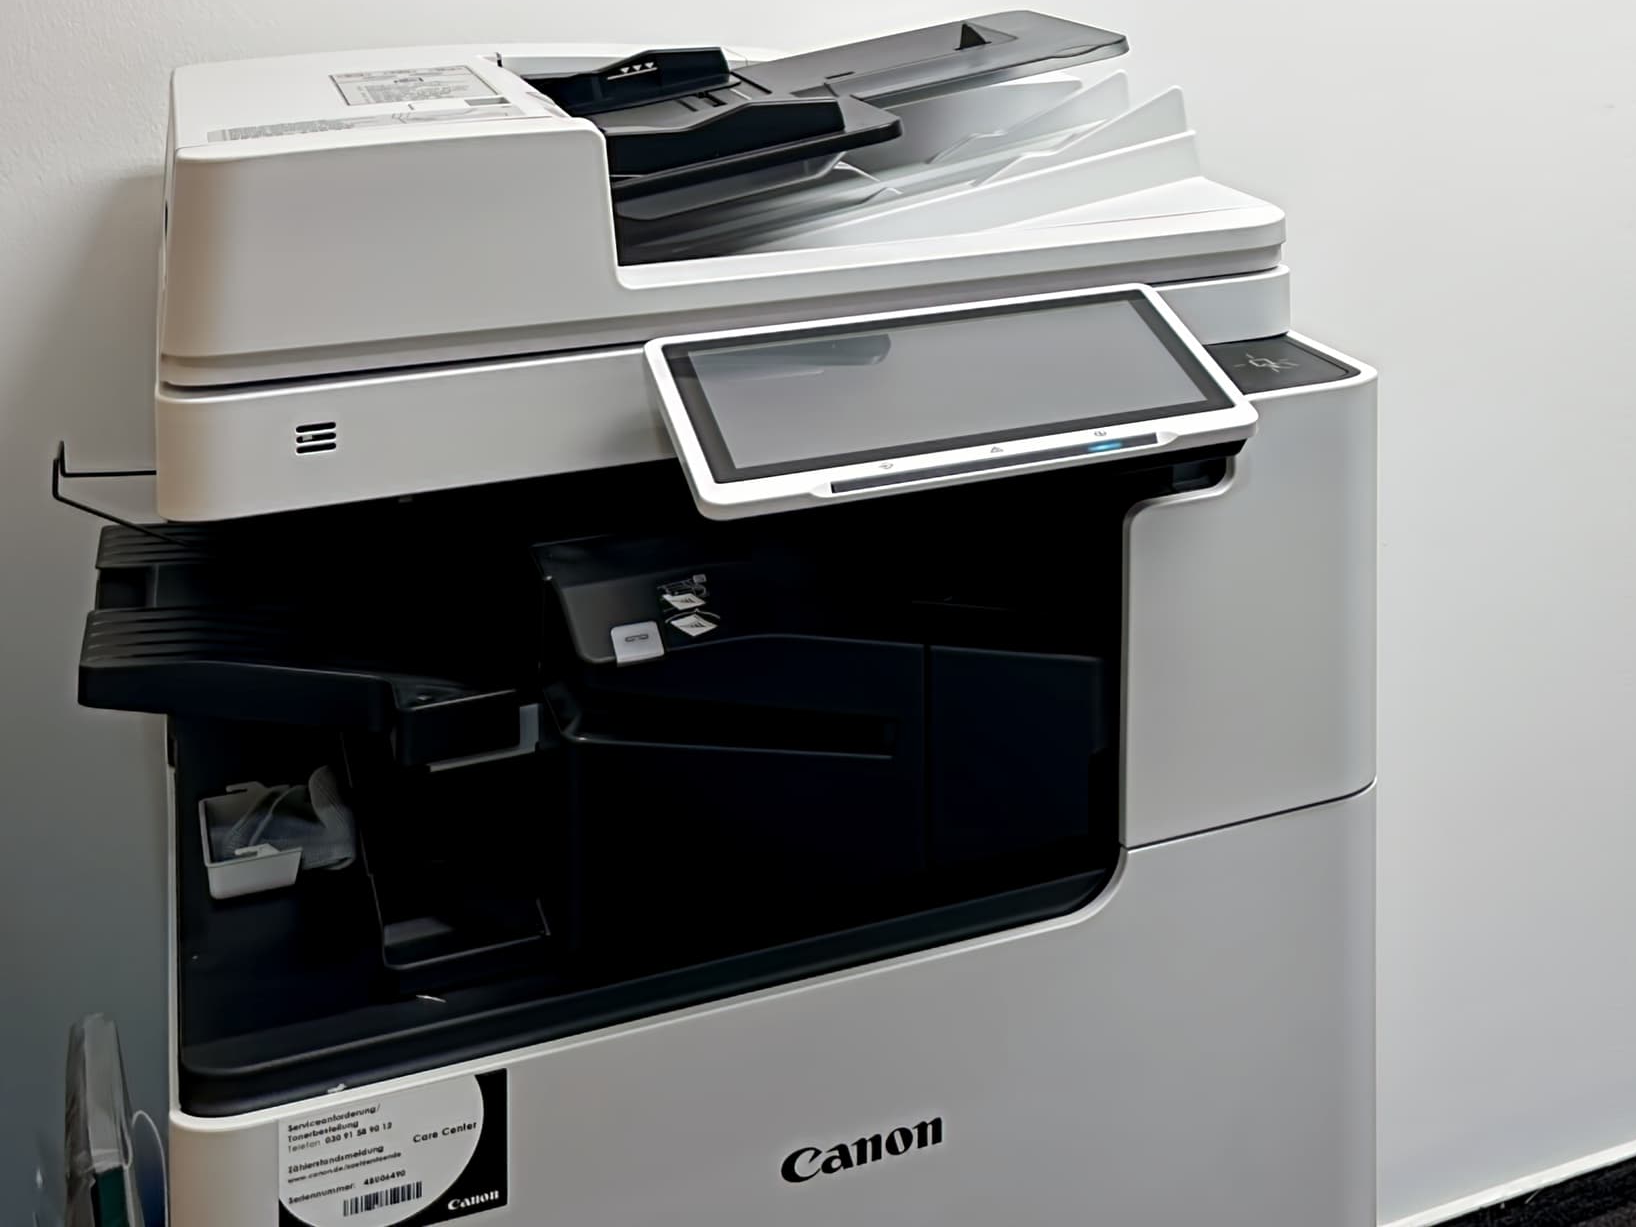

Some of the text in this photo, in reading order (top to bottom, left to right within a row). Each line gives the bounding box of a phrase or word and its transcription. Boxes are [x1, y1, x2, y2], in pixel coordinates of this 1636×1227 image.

[288, 1121, 359, 1142] Tonerbestellung
[413, 1122, 477, 1143] Care Center
[288, 1140, 321, 1153] Telefon
[781, 1117, 943, 1183] Canon
[448, 1190, 499, 1210] Canon
